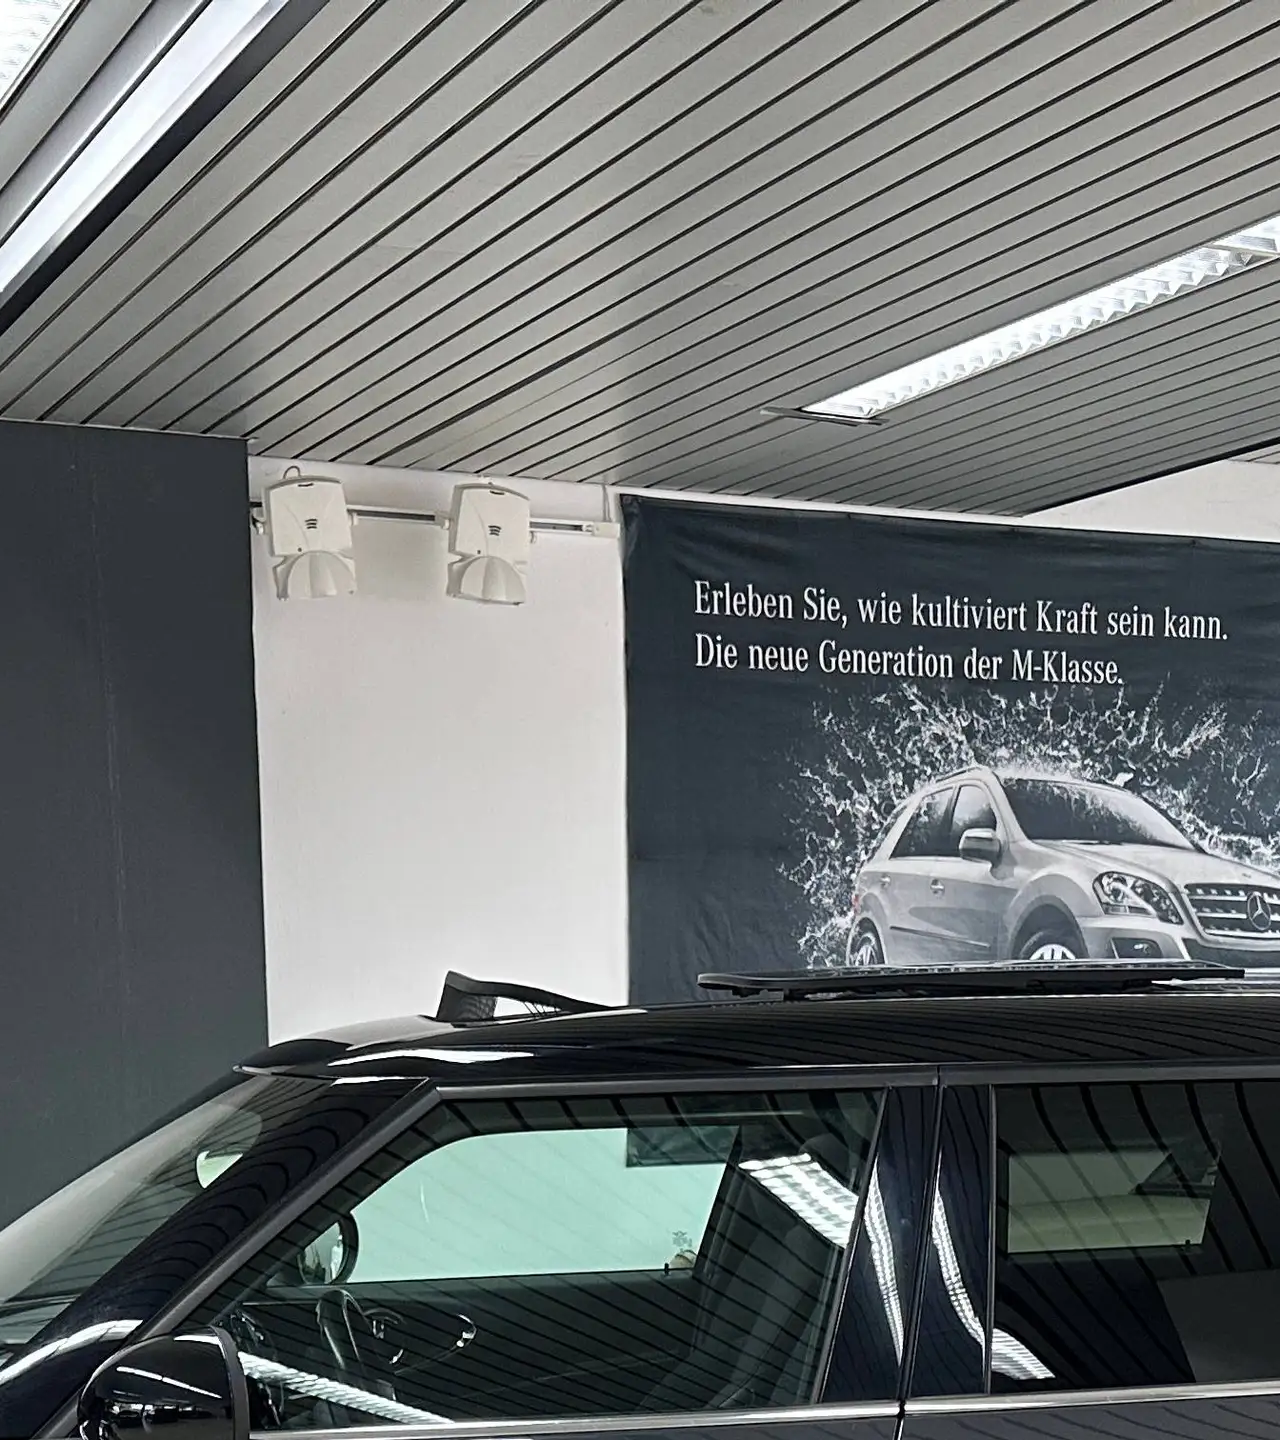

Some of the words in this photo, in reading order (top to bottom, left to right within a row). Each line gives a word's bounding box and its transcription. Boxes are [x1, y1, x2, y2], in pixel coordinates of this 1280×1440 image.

[694, 580, 793, 619] Erleben
[803, 587, 848, 629] Sie,
[857, 592, 902, 625] wie
[911, 594, 1027, 632] kultiviert
[1036, 601, 1098, 635] Kraft
[1106, 605, 1154, 637] sein
[1163, 607, 1228, 640] kann.
[695, 633, 738, 668] Die
[748, 645, 809, 671] neue
[818, 640, 953, 679] Generation
[963, 648, 1003, 680] der
[1011, 649, 1125, 685] M-Klasse.
